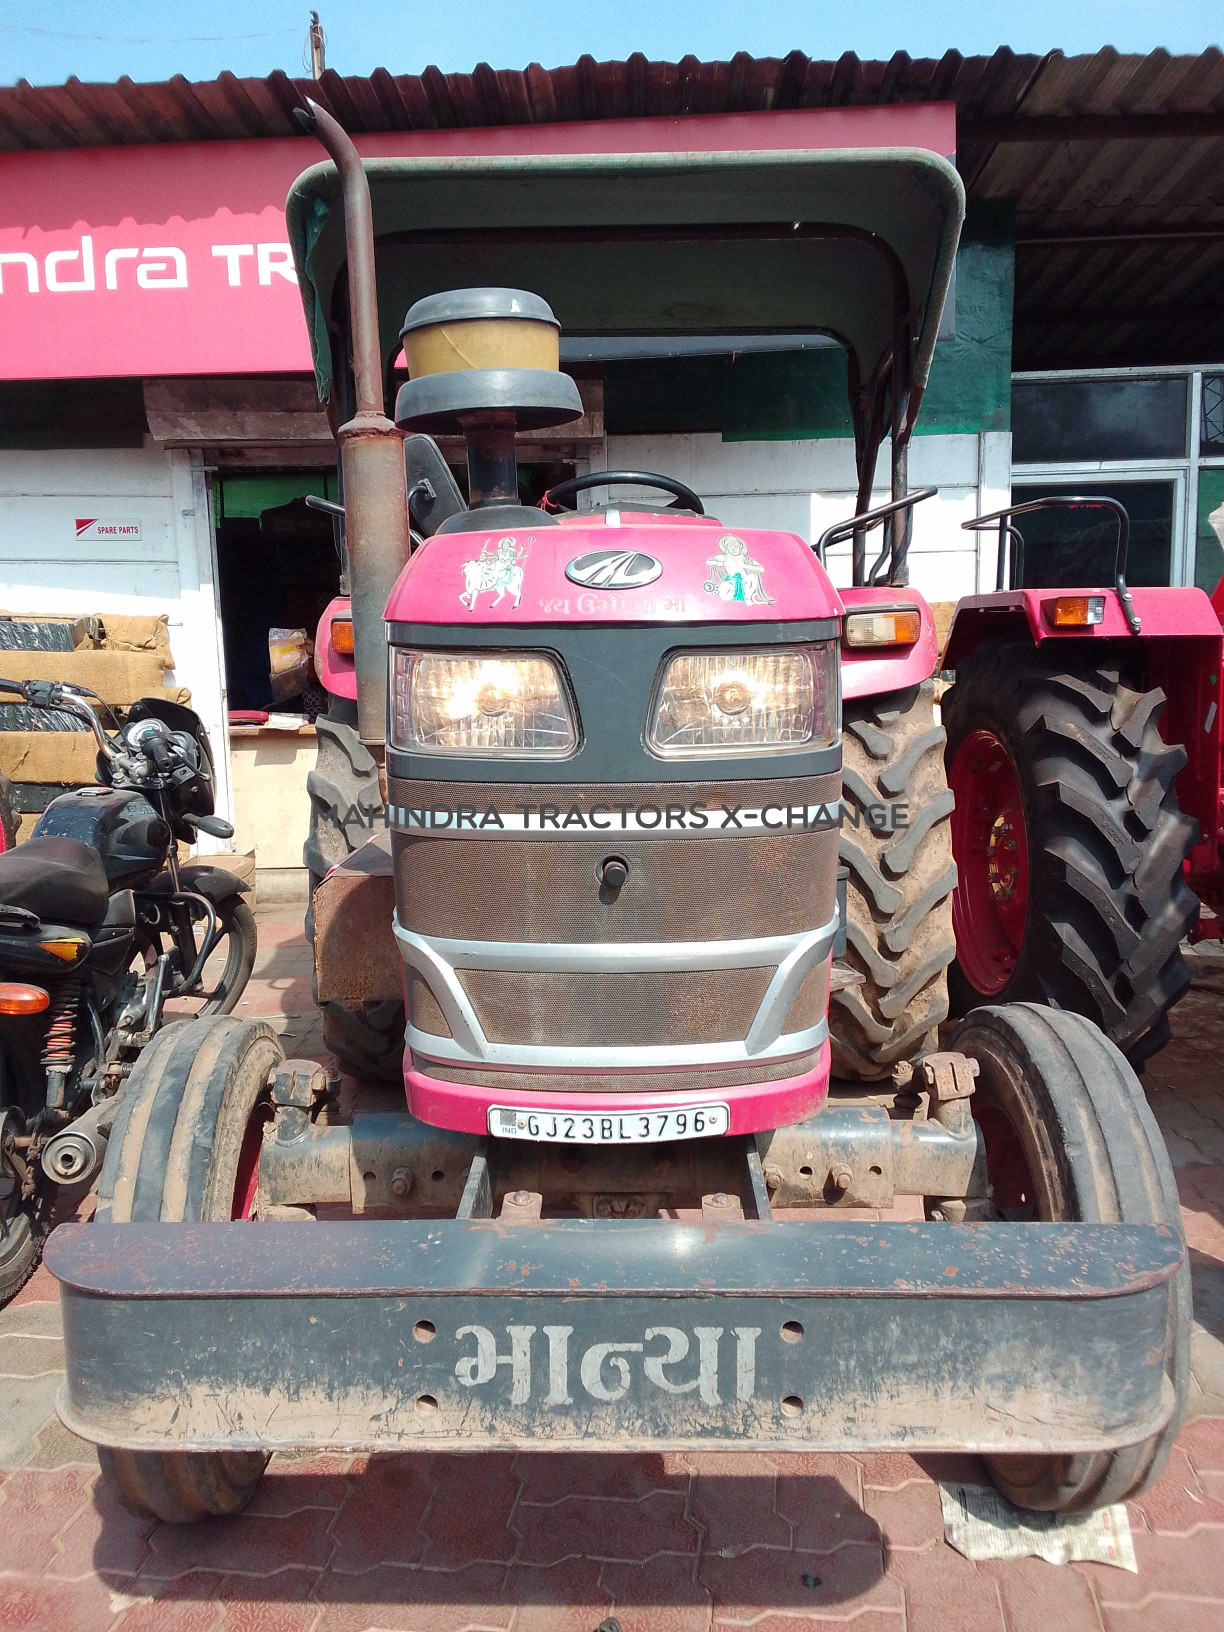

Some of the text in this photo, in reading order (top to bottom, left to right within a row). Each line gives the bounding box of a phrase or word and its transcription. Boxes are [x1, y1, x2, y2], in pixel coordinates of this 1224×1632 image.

[97, 526, 139, 534] SPARE PARTS
[539, 598, 571, 614] જય
[502, 1126, 517, 1135] IND
[527, 1111, 705, 1140] GJ23BL3796
[455, 1324, 762, 1407] માન્યા
